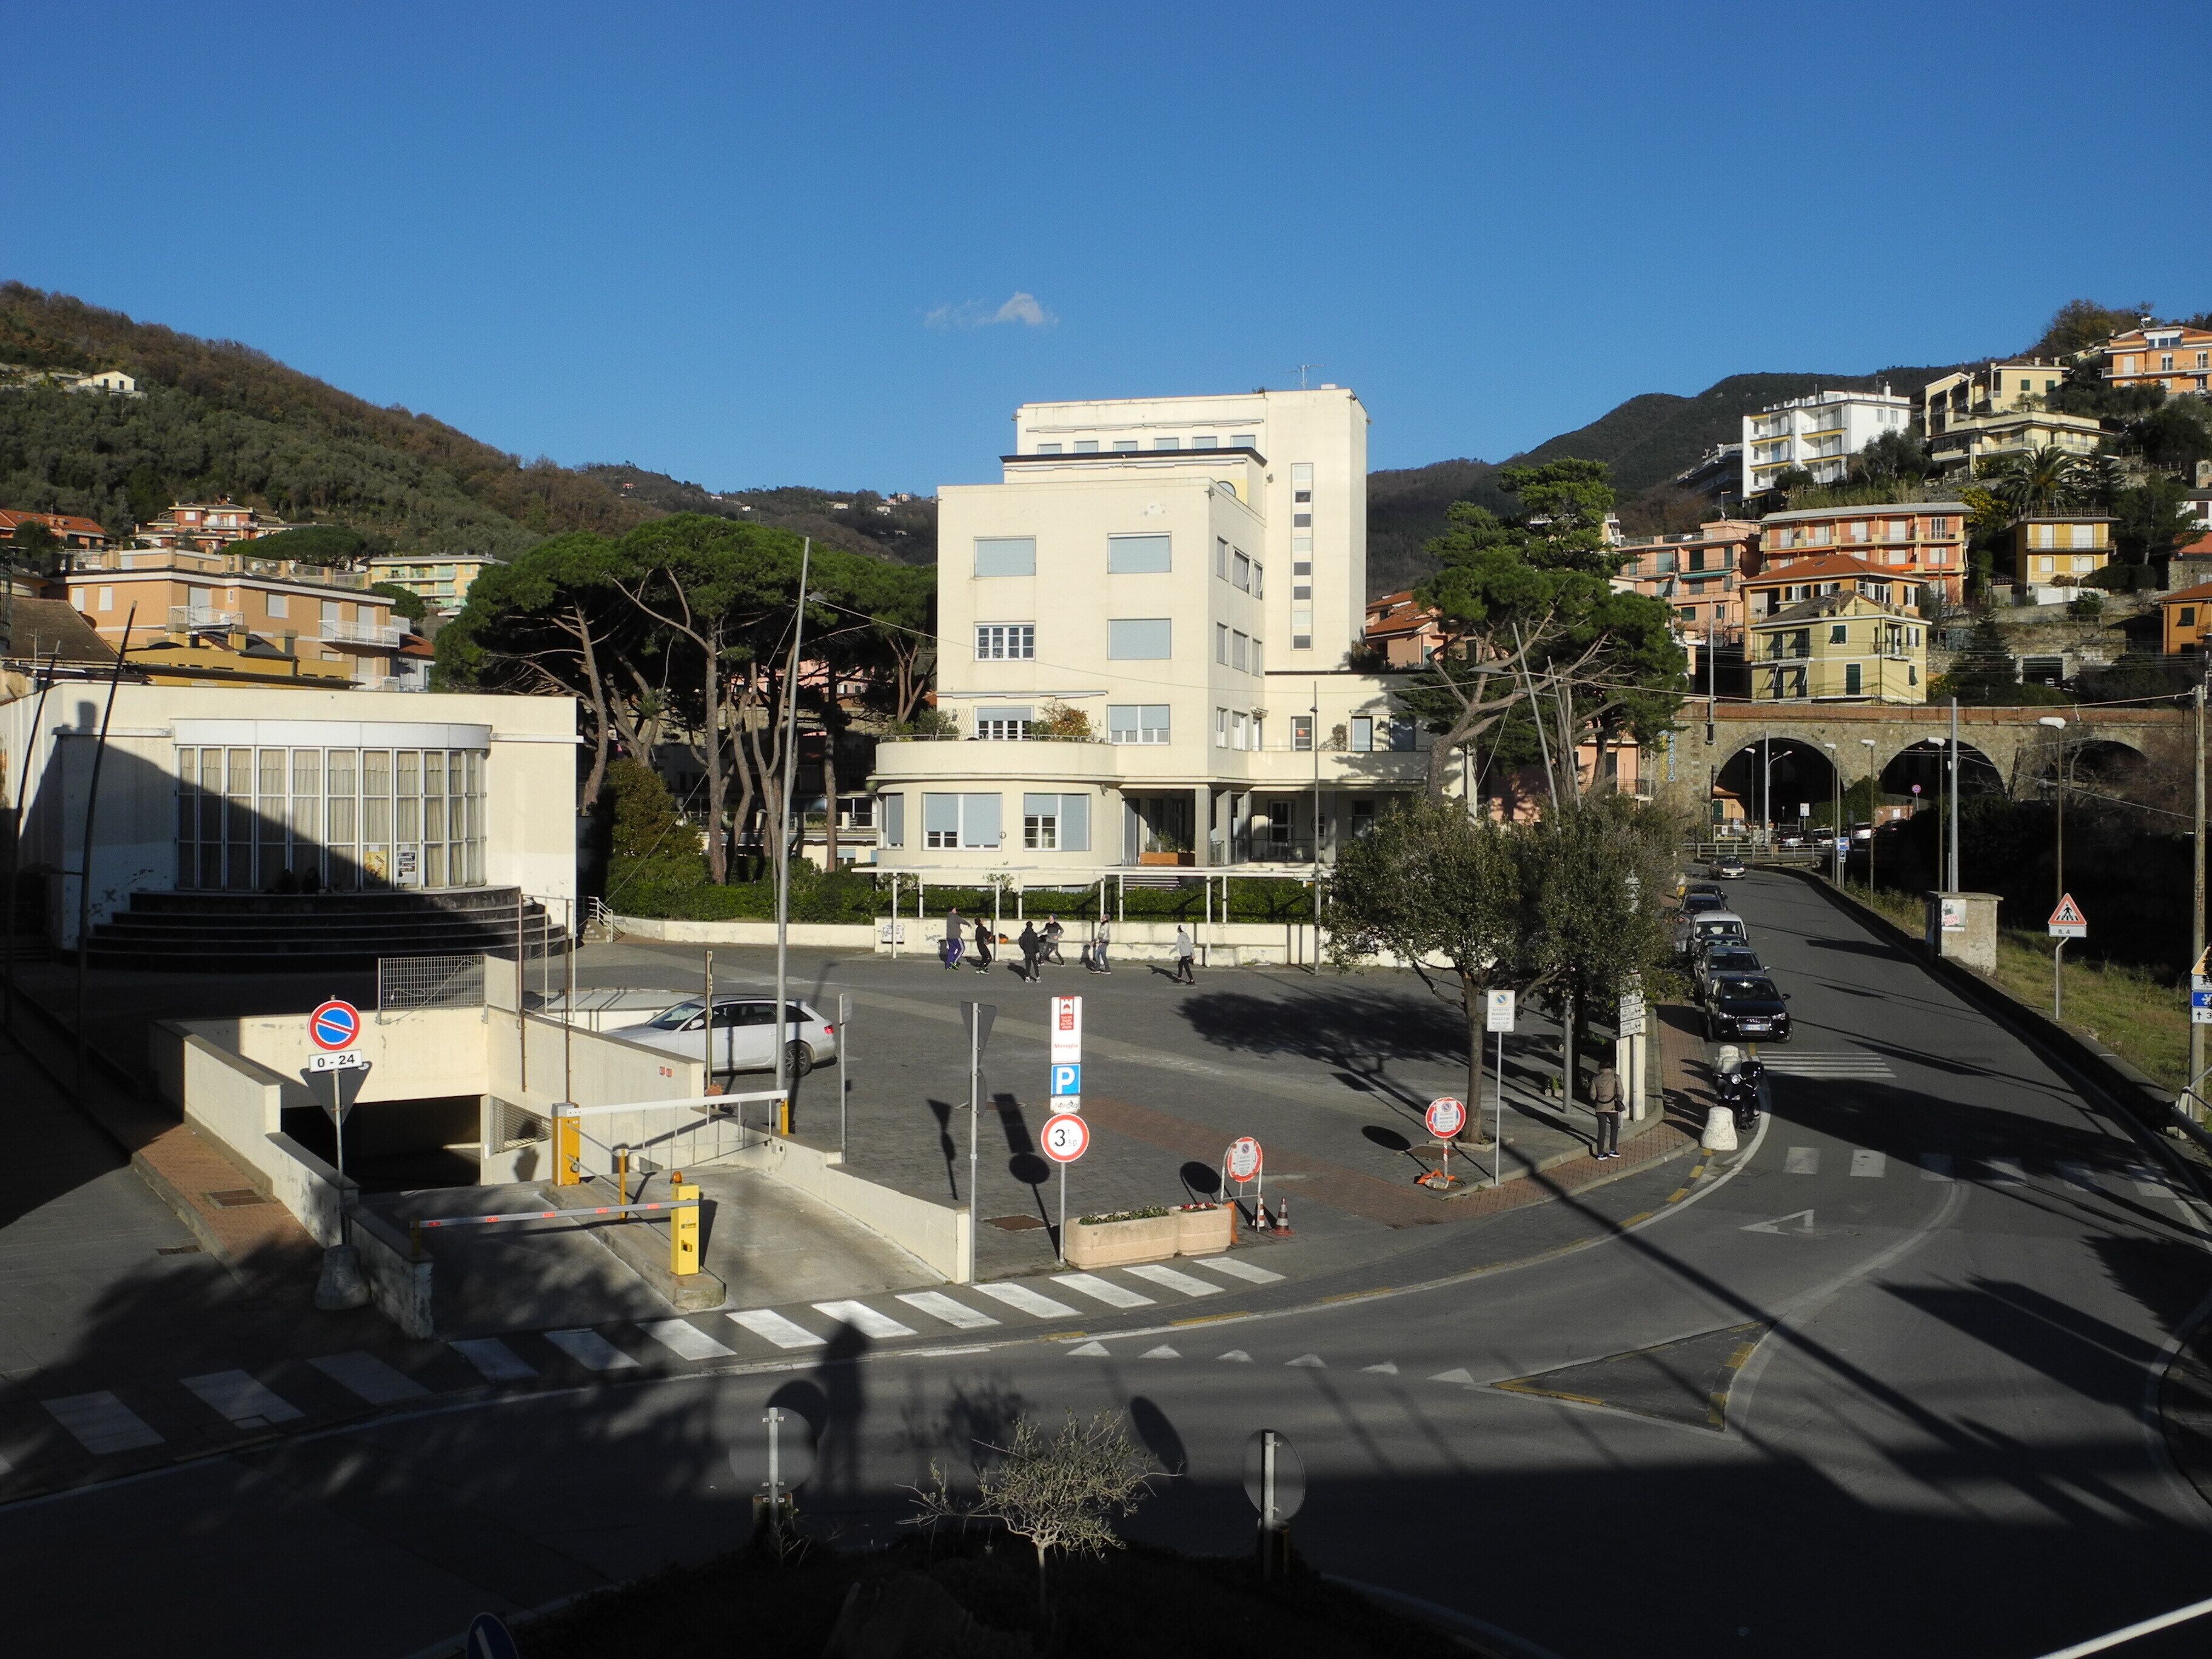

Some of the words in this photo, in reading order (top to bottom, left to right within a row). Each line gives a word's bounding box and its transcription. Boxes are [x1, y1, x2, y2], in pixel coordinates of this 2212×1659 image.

[318, 1058, 325, 1068] 0
[339, 1054, 355, 1065] 24
[1056, 1067, 1075, 1094] P
[1054, 1129, 1065, 1147] 3
